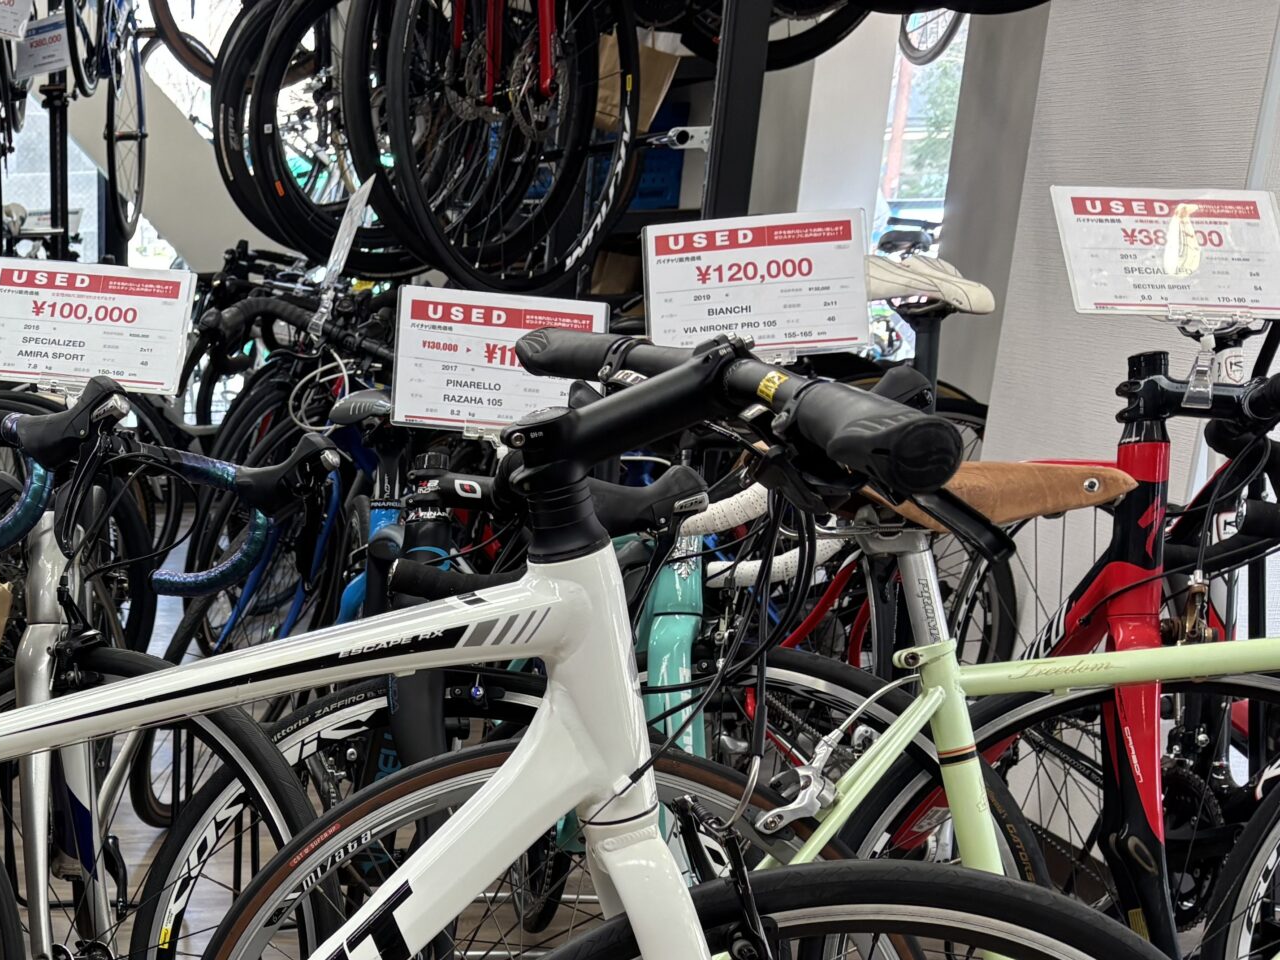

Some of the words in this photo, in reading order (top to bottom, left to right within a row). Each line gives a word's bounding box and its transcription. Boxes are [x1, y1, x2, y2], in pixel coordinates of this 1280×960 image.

[1085, 200, 1170, 217] USED
[668, 229, 753, 251] USED
[696, 257, 813, 284] ¥120,000
[12, 270, 90, 288] USED
[693, 293, 711, 301] 2019
[32, 300, 138, 325] ¥100,000
[427, 304, 507, 324] USED
[707, 305, 752, 316] BIANCHI
[23, 323, 40, 331] 2015
[683, 326, 698, 334] VIA
[699, 322, 739, 333] NIRONE7
[741, 320, 760, 329] PRO
[762, 319, 777, 328] 105
[783, 330, 813, 339] 155-165
[21, 336, 86, 348] SPECIALIZED
[422, 339, 458, 353] ¥130,000
[17, 349, 49, 359] AMIRA
[51, 351, 85, 362] SPORT
[97, 368, 124, 376] 150-160
[441, 364, 458, 372] 2017
[446, 378, 501, 391] PINARELLO
[443, 394, 484, 405] RAZAHA
[487, 397, 503, 407] 105
[338, 635, 413, 659] ESCAPE
[417, 629, 446, 641] RX
[1008, 659, 1125, 680] Freedom
[314, 693, 365, 717] ZAFFIRO
[1124, 726, 1144, 783] CARBON
